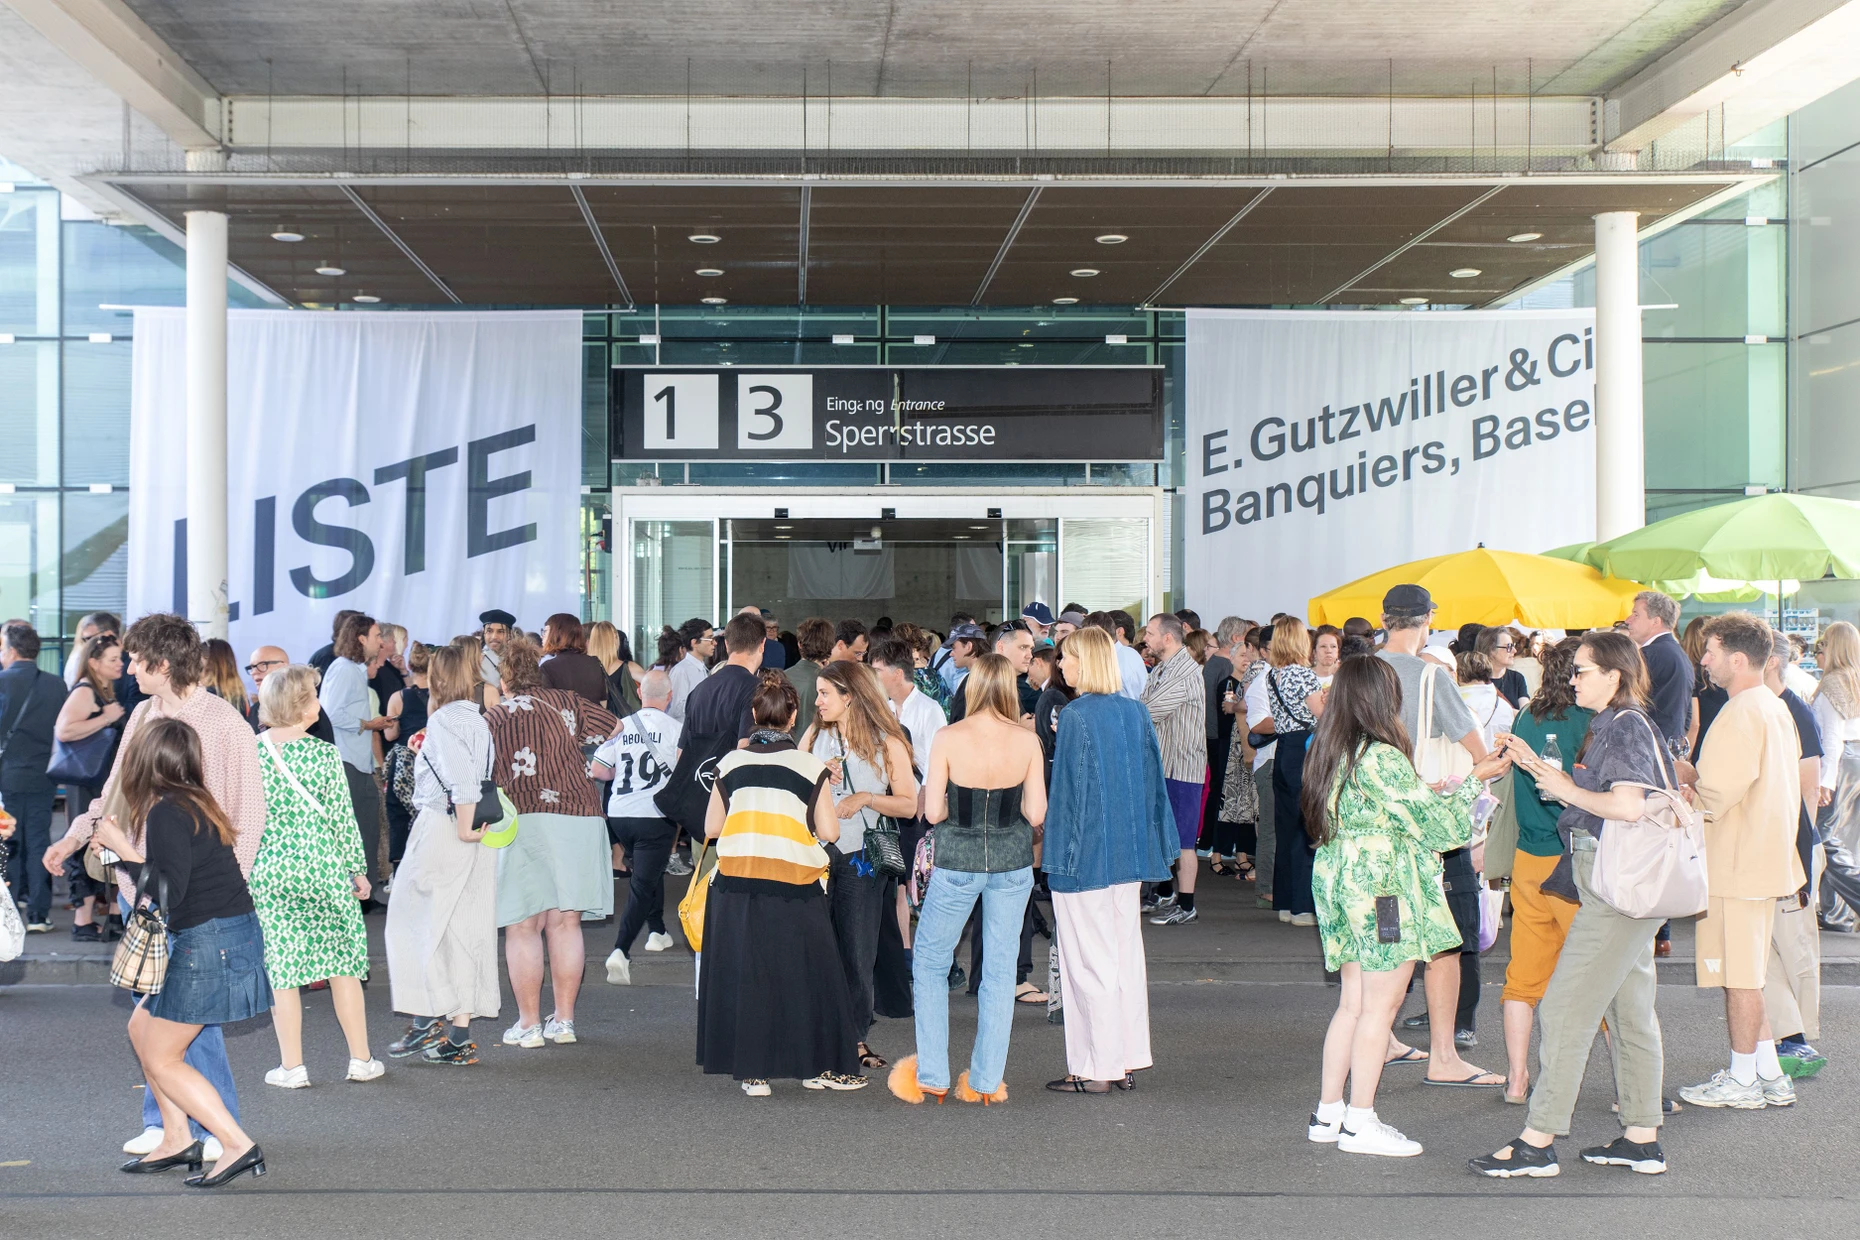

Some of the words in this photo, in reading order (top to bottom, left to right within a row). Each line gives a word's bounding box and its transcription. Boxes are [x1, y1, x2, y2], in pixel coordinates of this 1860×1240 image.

[654, 385, 676, 440] 1
[747, 385, 784, 441] 3
[890, 399, 945, 411] Entrance
[1250, 365, 1498, 461] Gutzwiller
[1504, 348, 1541, 392] &
[825, 419, 996, 453] Sperrstrasse
[1202, 440, 1460, 535] Banquiers,
[616, 750, 662, 796] 19
